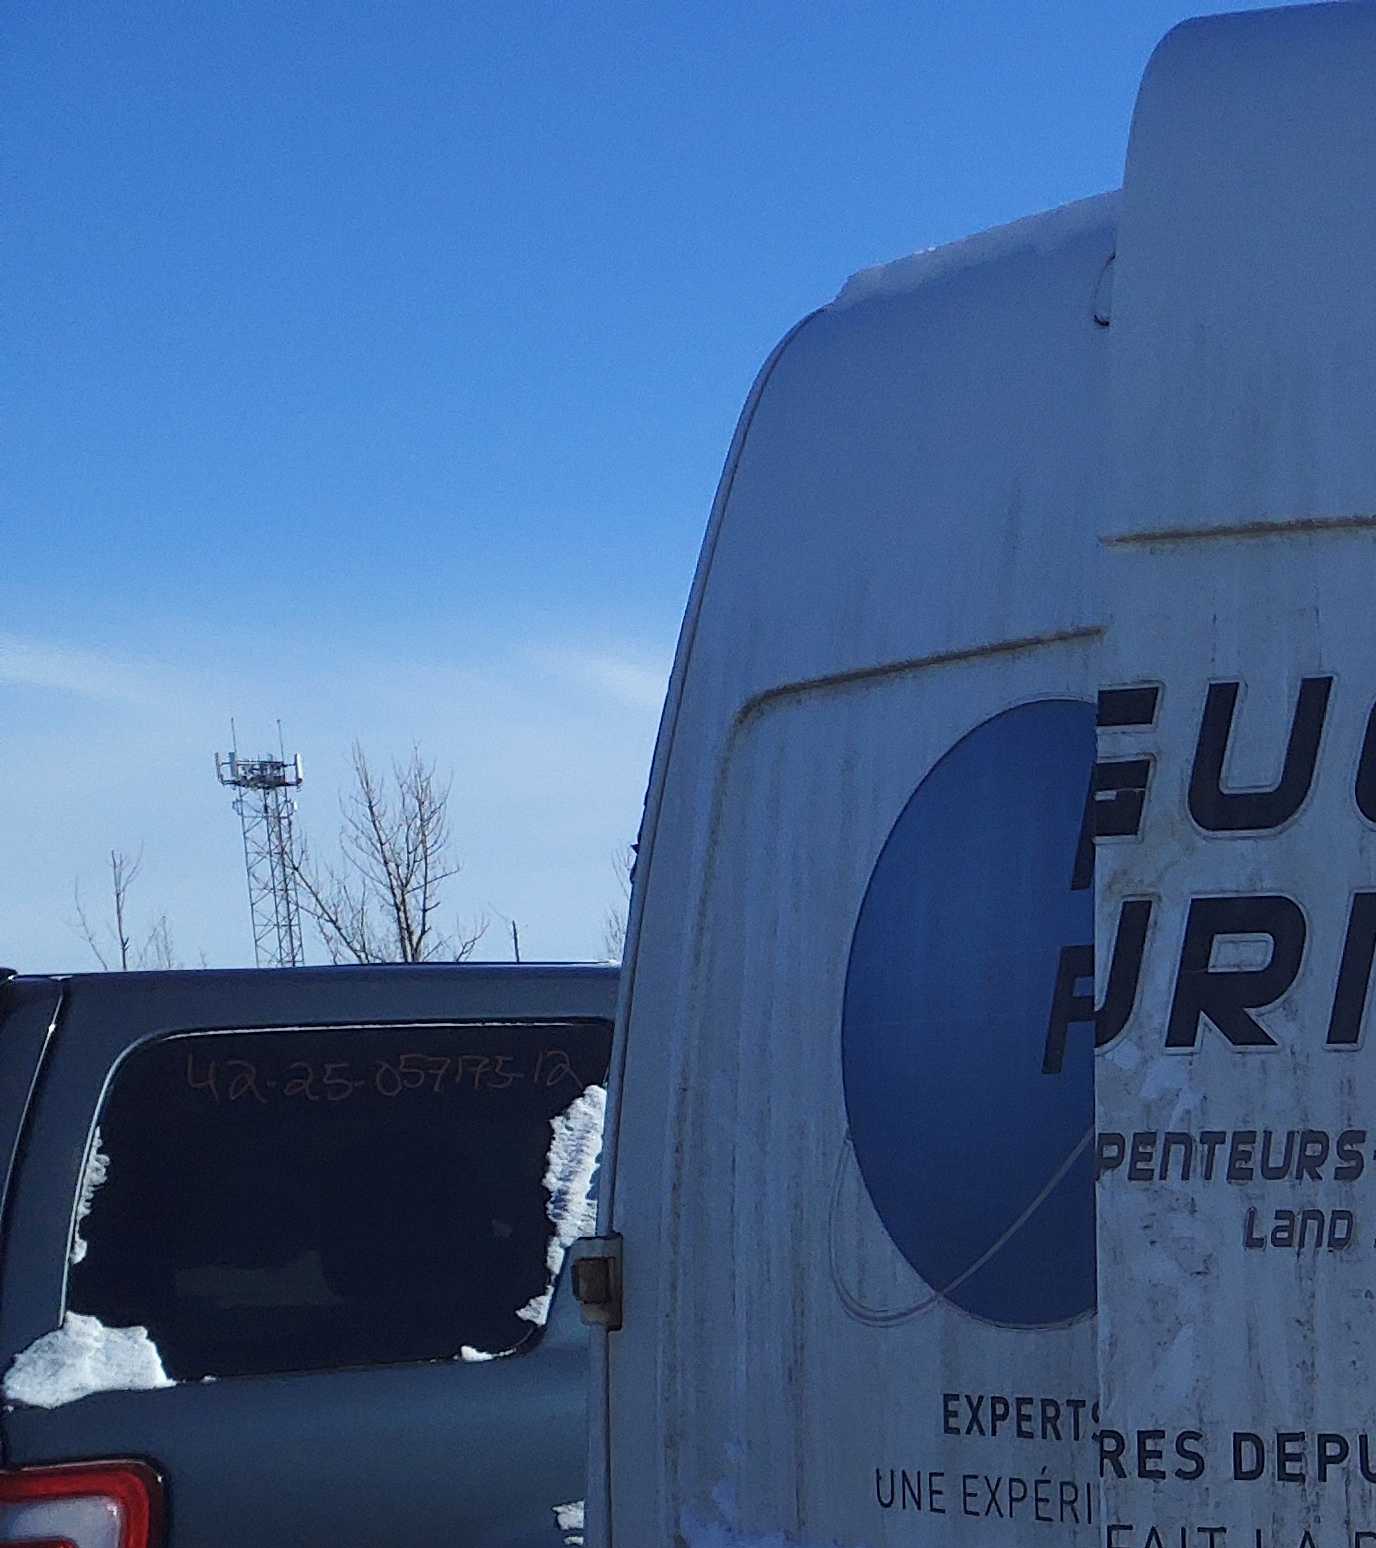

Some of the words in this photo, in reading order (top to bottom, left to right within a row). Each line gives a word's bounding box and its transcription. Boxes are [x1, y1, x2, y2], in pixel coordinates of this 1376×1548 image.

[1099, 1428, 1206, 1481] RES
[875, 1467, 946, 1515] UNE
[962, 1465, 1094, 1526] EXPÉRI
